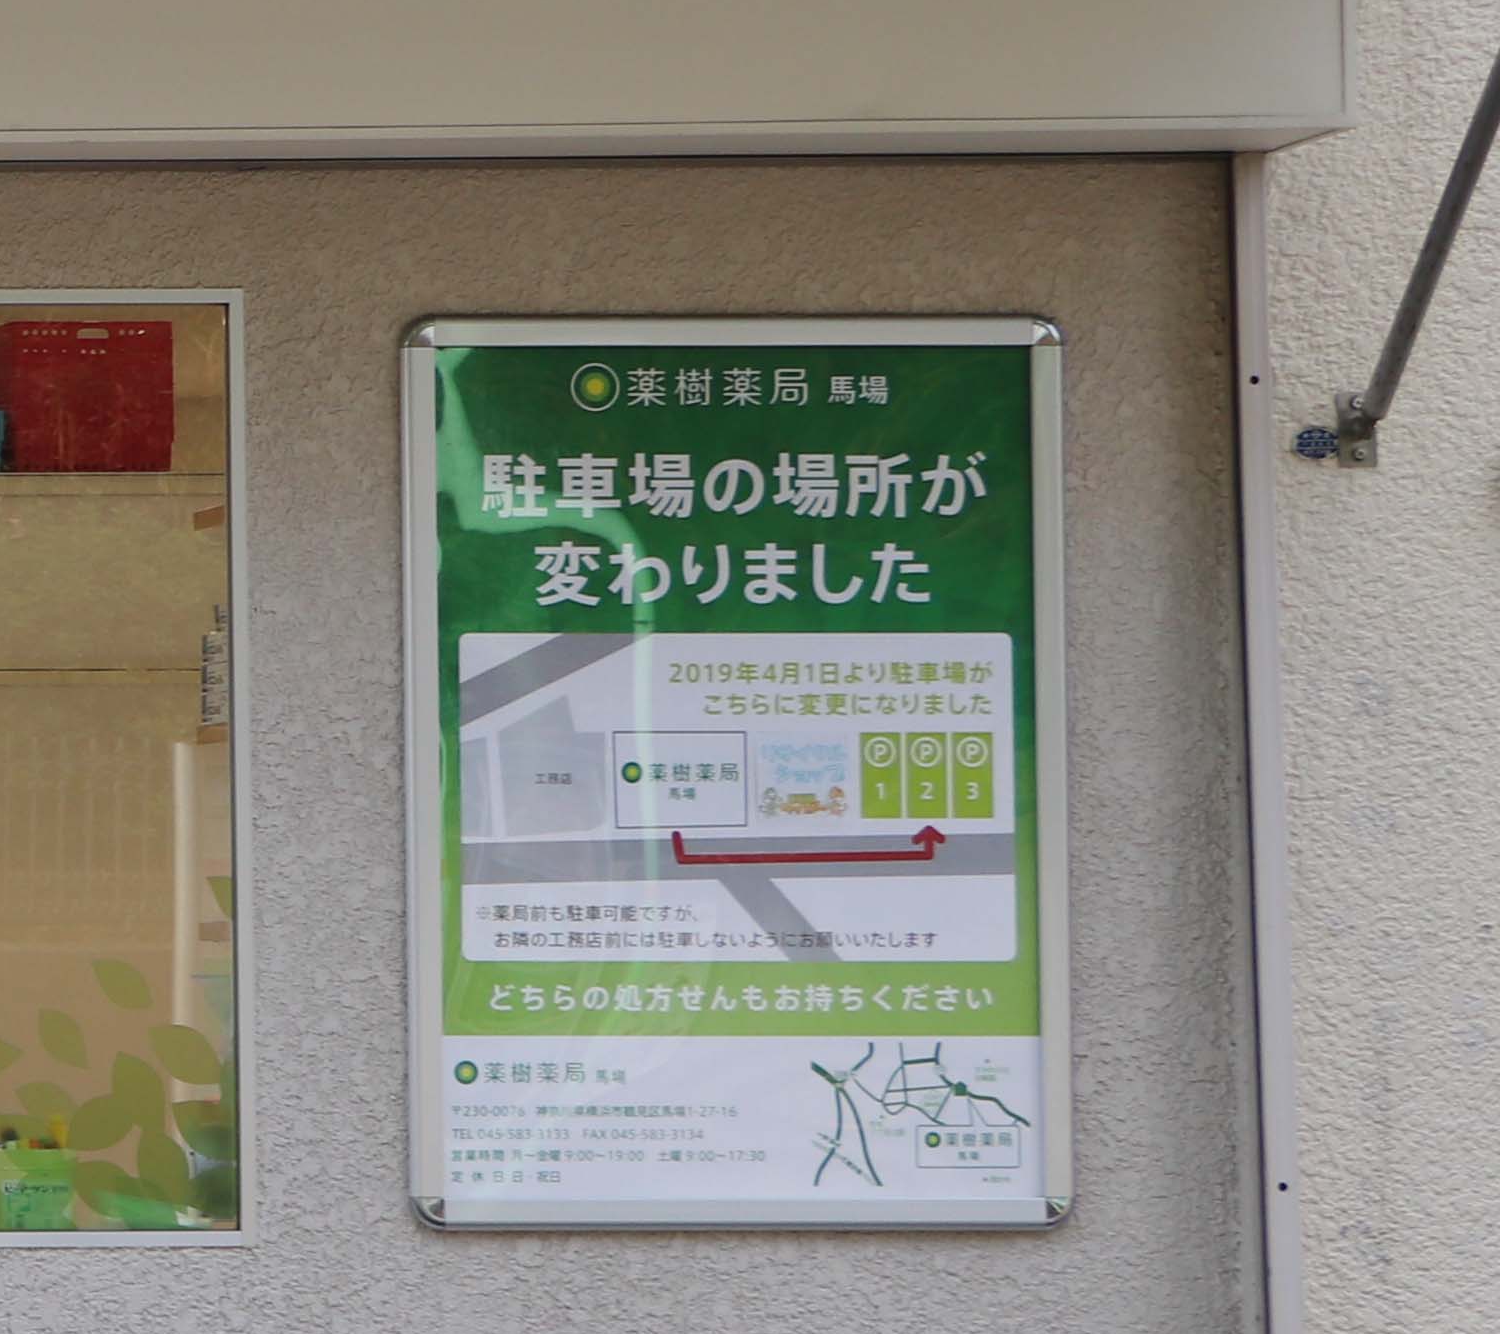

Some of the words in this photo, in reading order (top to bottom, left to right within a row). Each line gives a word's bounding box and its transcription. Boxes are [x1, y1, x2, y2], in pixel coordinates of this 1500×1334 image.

[627, 367, 809, 407] 薬樹薬局
[828, 375, 890, 405] 馬場
[481, 451, 988, 520] 駐車場の場所が
[533, 541, 933, 608] 変わりました
[668, 660, 994, 687] 2019年4月1日より駐車場が
[703, 692, 994, 718] こちらに変更になりました
[920, 782, 934, 800] 2
[966, 782, 980, 800] 3
[488, 983, 996, 1014] どちらの処方せんもお持ちください
[483, 1062, 586, 1084] 薬樹薬局
